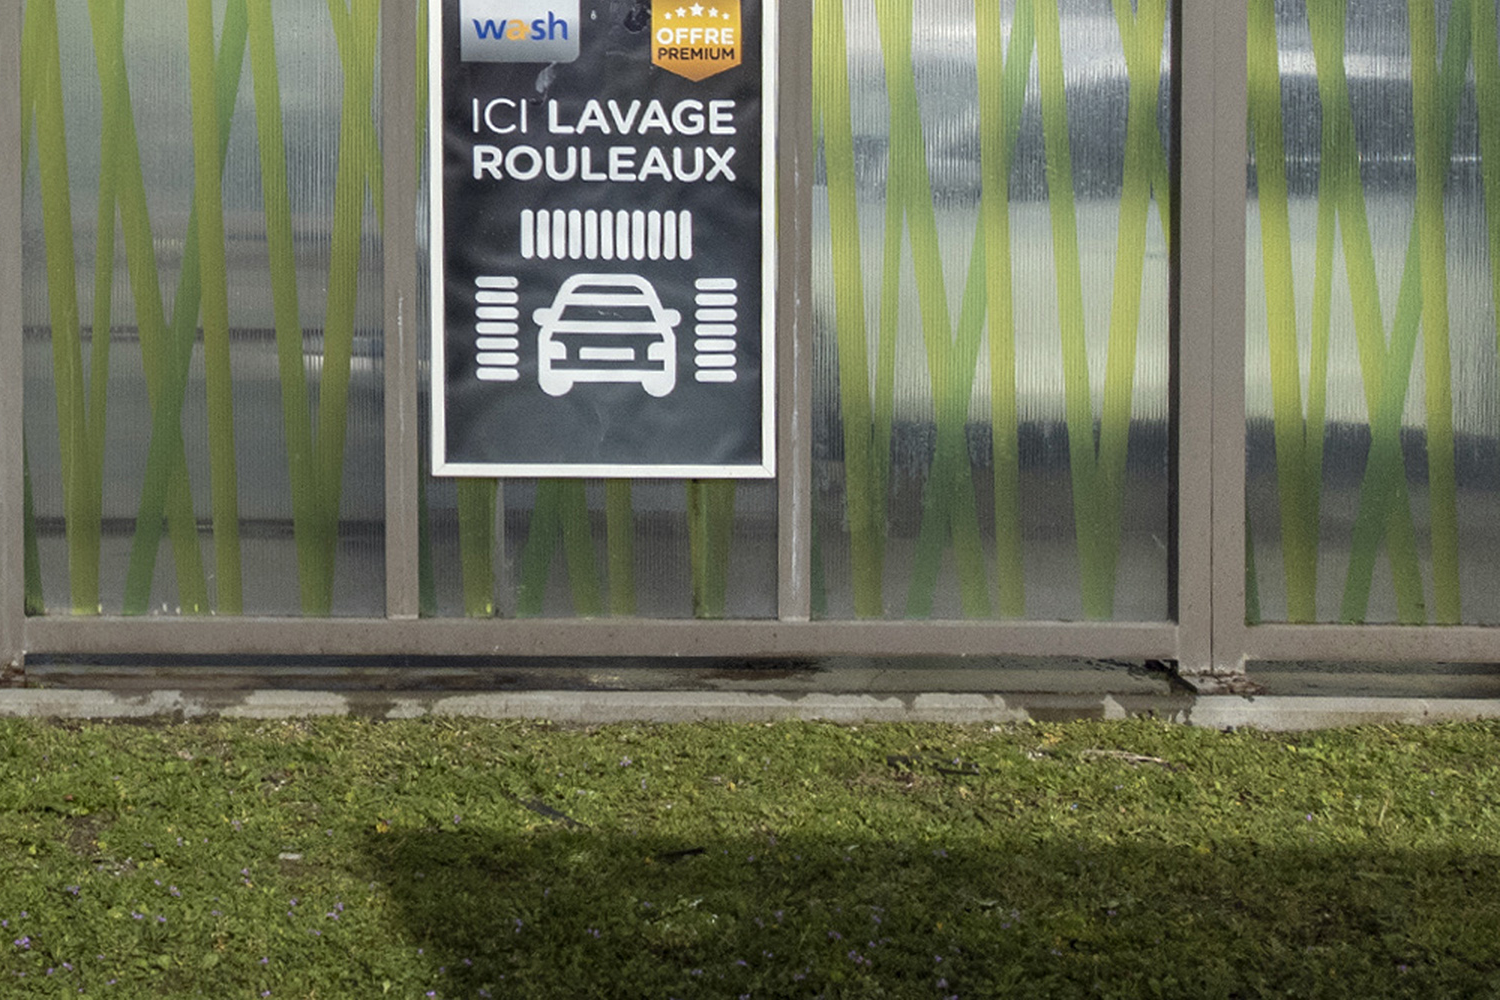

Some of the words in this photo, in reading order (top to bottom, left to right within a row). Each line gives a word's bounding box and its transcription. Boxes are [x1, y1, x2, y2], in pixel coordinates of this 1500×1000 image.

[472, 10, 569, 41] wash
[656, 27, 735, 46] OFFRE
[657, 47, 735, 61] PREMIUM
[472, 98, 528, 134] ICI
[548, 99, 738, 135] LAVAGE
[472, 145, 737, 182] ROULEAUX
